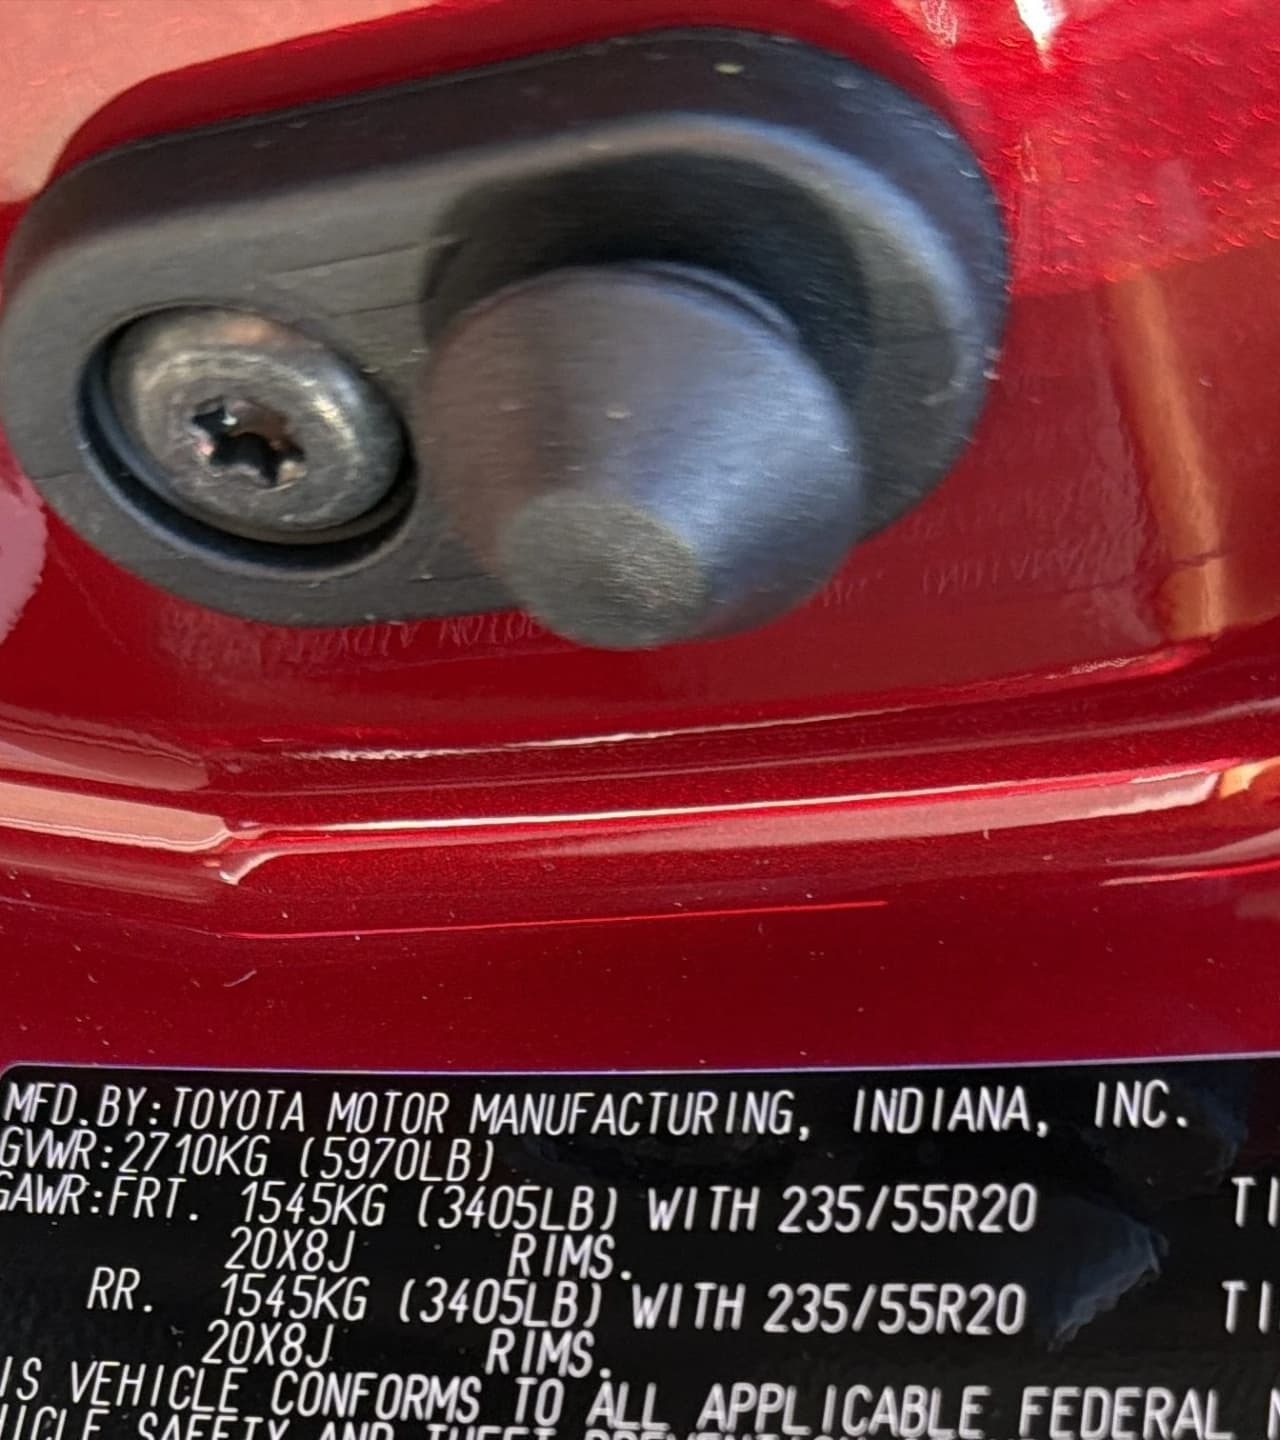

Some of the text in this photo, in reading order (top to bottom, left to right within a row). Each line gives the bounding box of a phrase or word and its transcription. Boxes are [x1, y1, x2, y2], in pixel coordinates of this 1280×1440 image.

[326, 1091, 451, 1135] MOTOR
[469, 1089, 810, 1142] MANUFACTURING,
[853, 1085, 1049, 1138] INDIANA,
[1094, 1079, 1189, 1129] INC.
[300, 1135, 494, 1183] (5970LB)
[241, 1182, 389, 1227] 1545KG
[417, 1184, 619, 1231] (3405LB)
[647, 1186, 761, 1231] WITH
[777, 1183, 1039, 1234] 235/55R20
[225, 1227, 632, 1280] 20X8J RIMS.
[86, 1266, 153, 1313] RR.
[220, 1273, 371, 1320] 1545KG
[399, 1277, 602, 1329] (3405LB)
[631, 1282, 747, 1330] WITH
[763, 1282, 1027, 1335] 235/55R20
[201, 1319, 612, 1378] 20X8J RIMS.
[71, 1361, 249, 1415] VEHICLE
[270, 1370, 481, 1424] CONFORMS
[515, 1376, 565, 1427] TO
[585, 1381, 670, 1431] ALL
[697, 1382, 991, 1440] APPLICABLE
